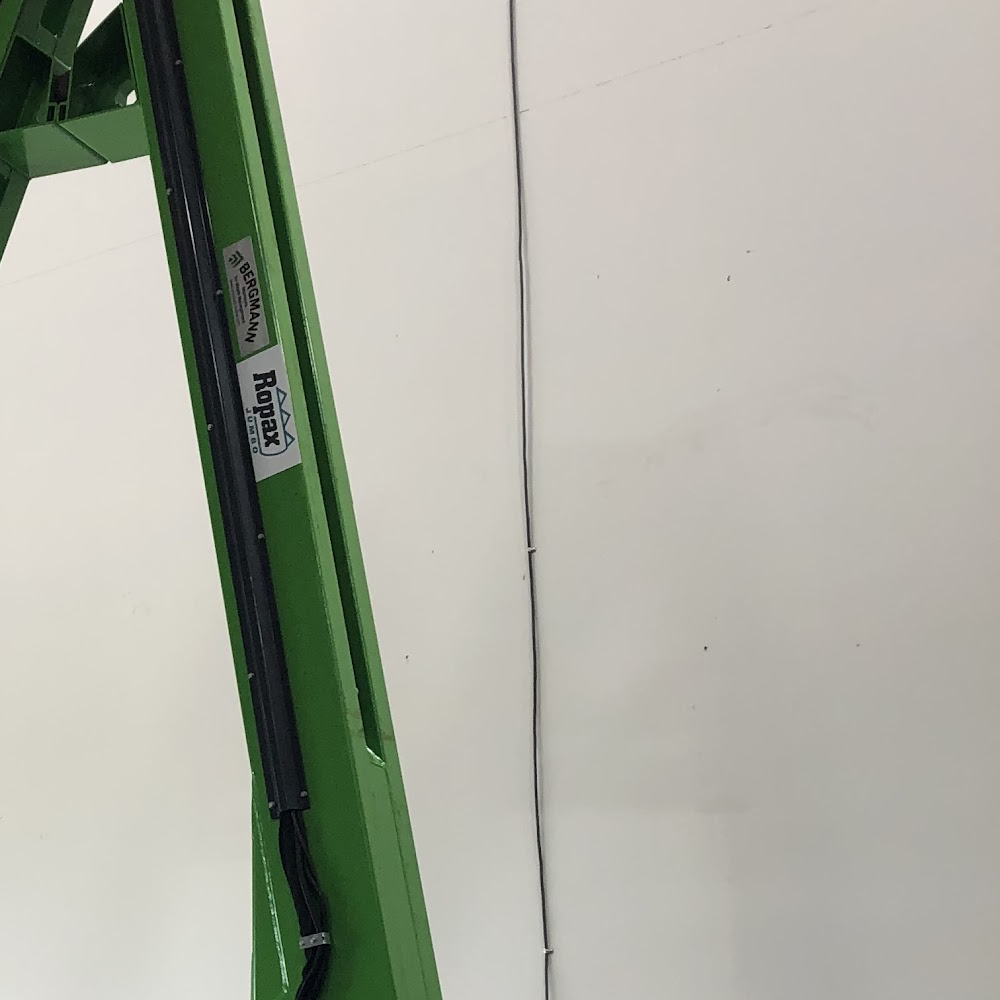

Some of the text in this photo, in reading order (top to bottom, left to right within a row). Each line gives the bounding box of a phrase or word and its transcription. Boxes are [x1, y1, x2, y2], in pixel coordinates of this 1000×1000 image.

[239, 261, 261, 344] BERGMANN
[245, 407, 259, 454] JUMBO
[252, 369, 281, 448] Ropax
